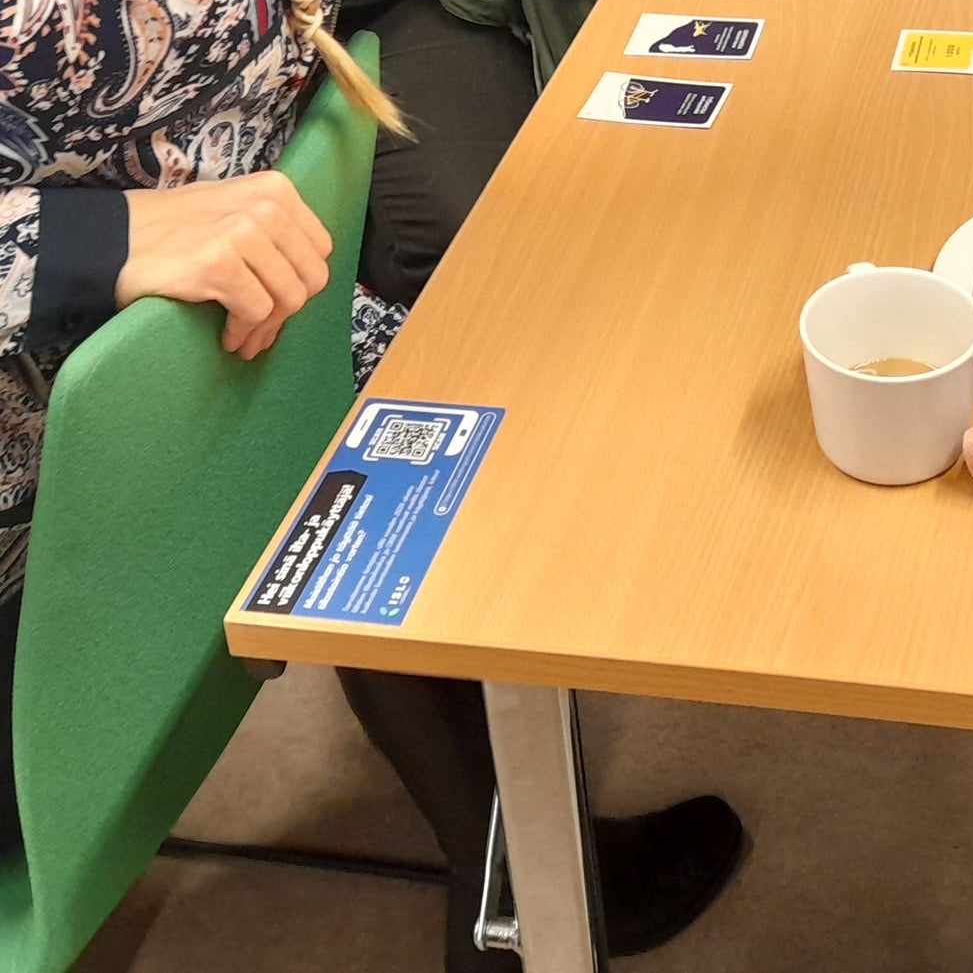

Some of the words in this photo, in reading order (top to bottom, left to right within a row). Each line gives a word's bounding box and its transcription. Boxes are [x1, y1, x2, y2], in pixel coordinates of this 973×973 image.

[257, 582, 277, 605] Hei
[275, 555, 296, 581] sinä
[304, 514, 321, 528] ja
[278, 484, 355, 606] viikonloppukäyttäjä!
